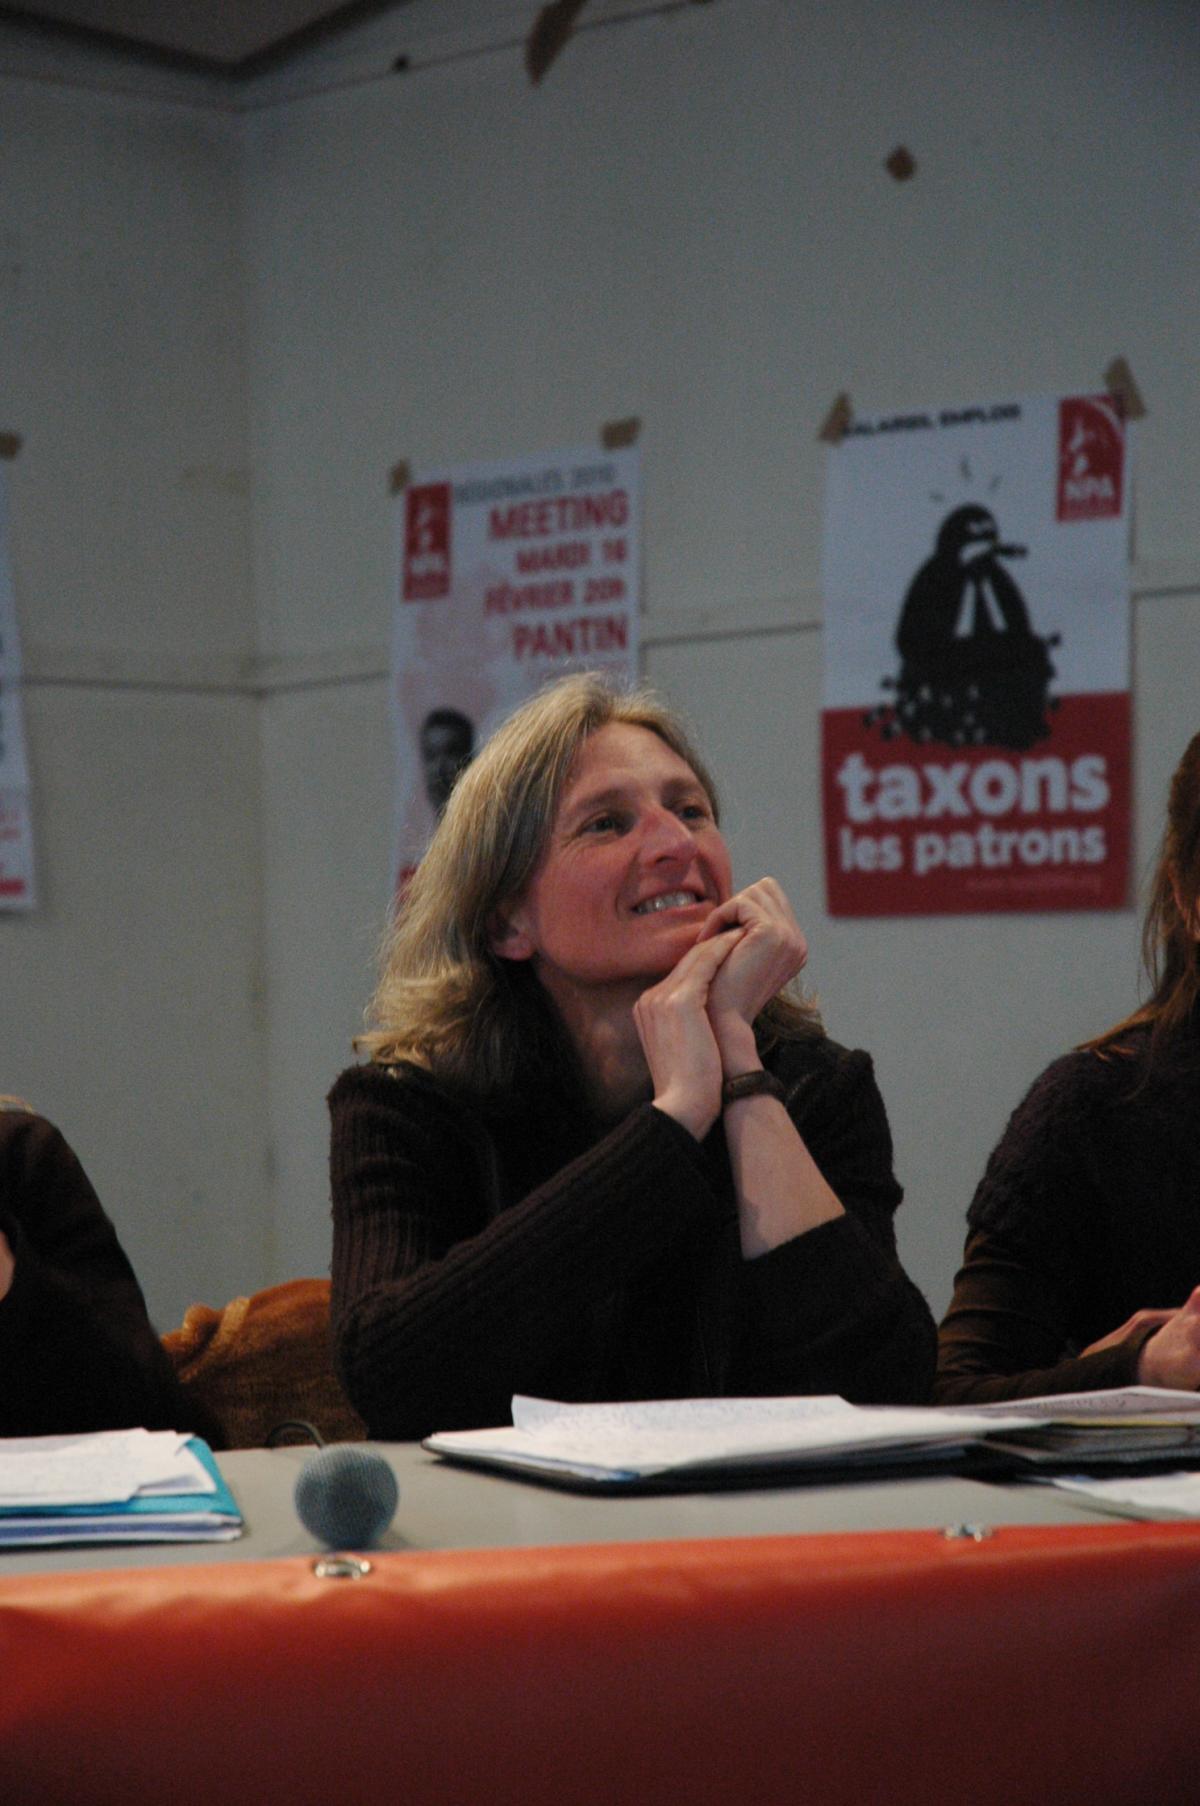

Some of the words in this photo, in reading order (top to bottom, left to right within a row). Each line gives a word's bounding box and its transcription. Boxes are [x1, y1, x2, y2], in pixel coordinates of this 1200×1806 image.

[1064, 474, 1115, 499] NPA
[489, 488, 629, 541] MEETING
[516, 541, 590, 574] MARDI
[513, 614, 628, 661] PANTIN
[837, 752, 1110, 823] taxons
[840, 826, 901, 871] les
[913, 822, 1106, 876] patrons
